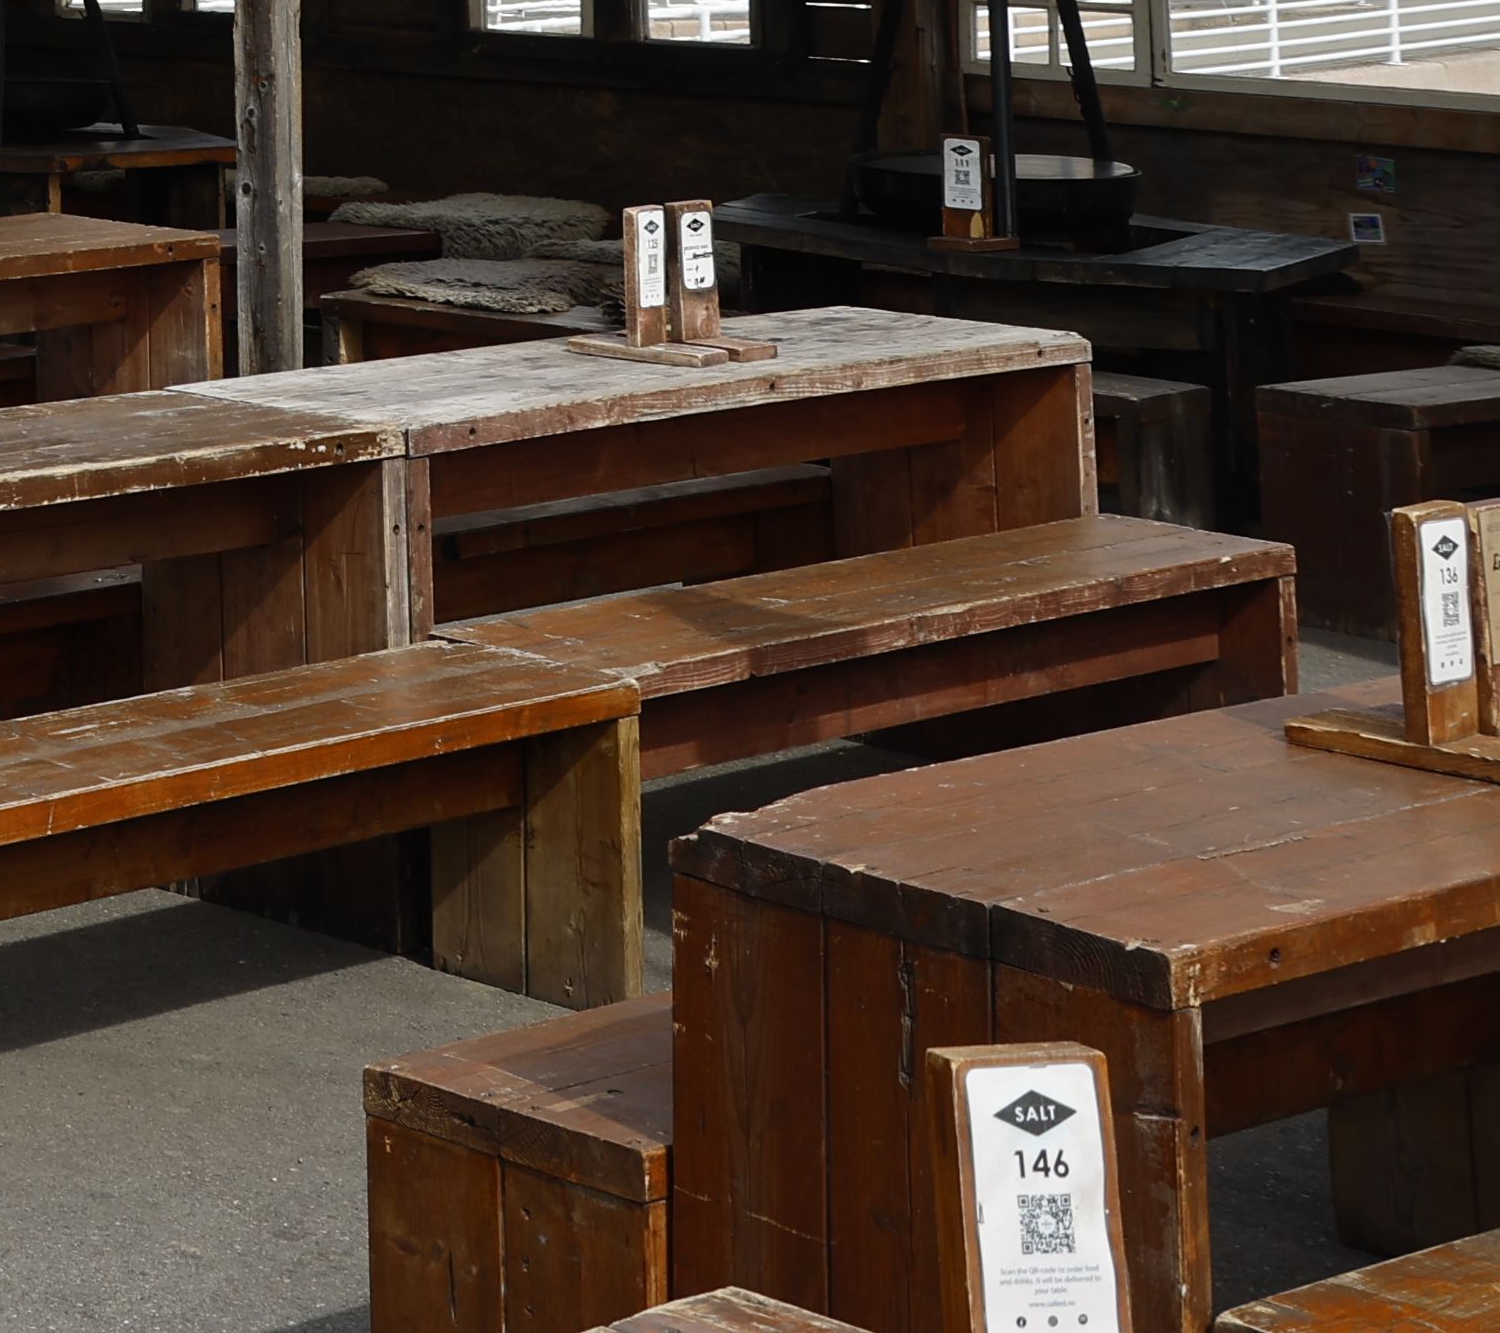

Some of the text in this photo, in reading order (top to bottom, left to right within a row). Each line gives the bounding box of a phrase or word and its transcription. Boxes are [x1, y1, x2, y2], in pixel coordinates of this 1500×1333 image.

[954, 157, 970, 168] 111
[1439, 566, 1459, 585] 136
[1014, 1104, 1056, 1123] SALT
[1013, 1148, 1071, 1179] 146
[1017, 1267, 1028, 1275] the
